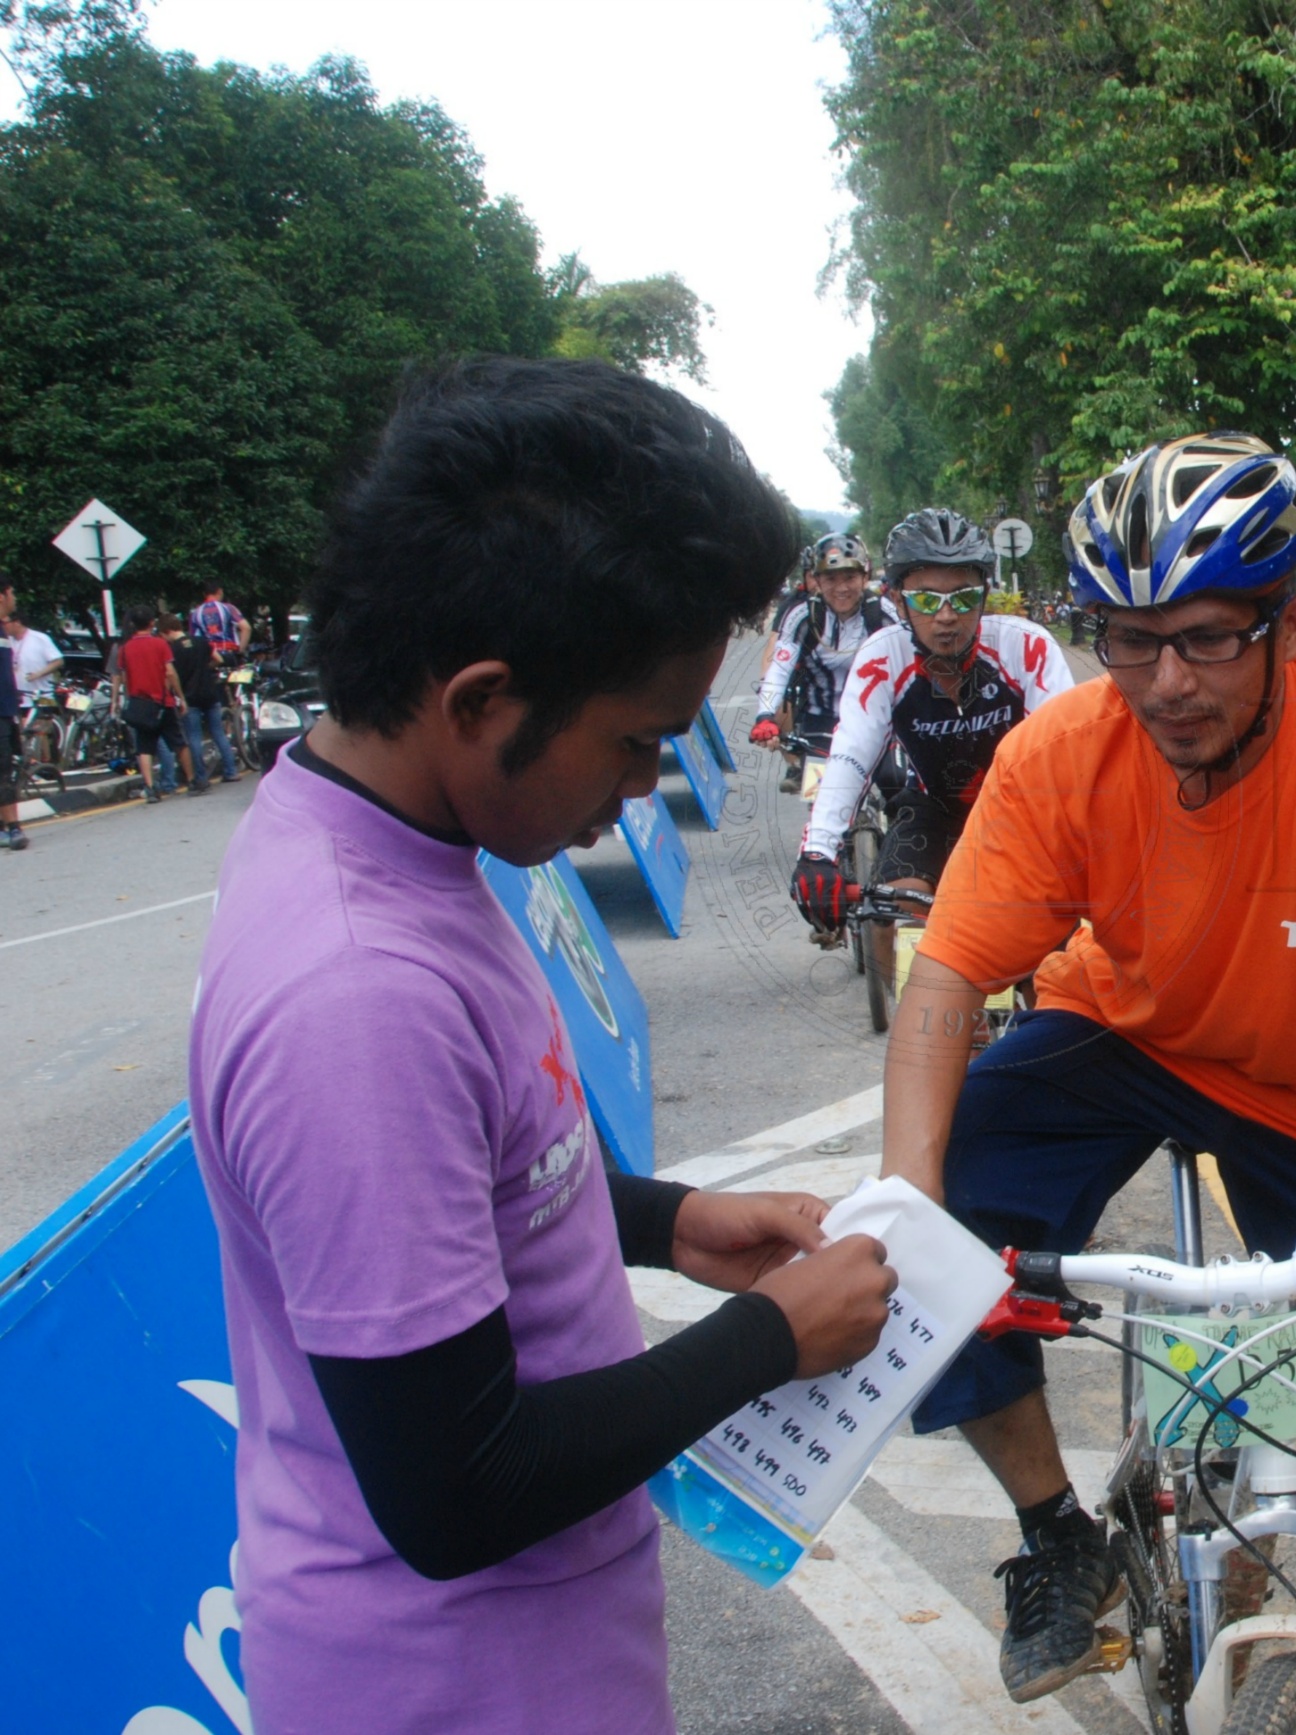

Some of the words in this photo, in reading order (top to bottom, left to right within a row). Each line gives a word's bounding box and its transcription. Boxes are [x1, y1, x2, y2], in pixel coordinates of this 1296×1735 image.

[910, 1317, 934, 1343] 477
[886, 1347, 907, 1371] 481
[857, 1376, 882, 1402] 489
[807, 1384, 831, 1411] 492
[835, 1408, 858, 1433] 493
[780, 1417, 805, 1444] 496
[807, 1438, 832, 1465] 497
[723, 1423, 751, 1453] 498
[755, 1448, 781, 1477] 499
[782, 1473, 808, 1497] 500
